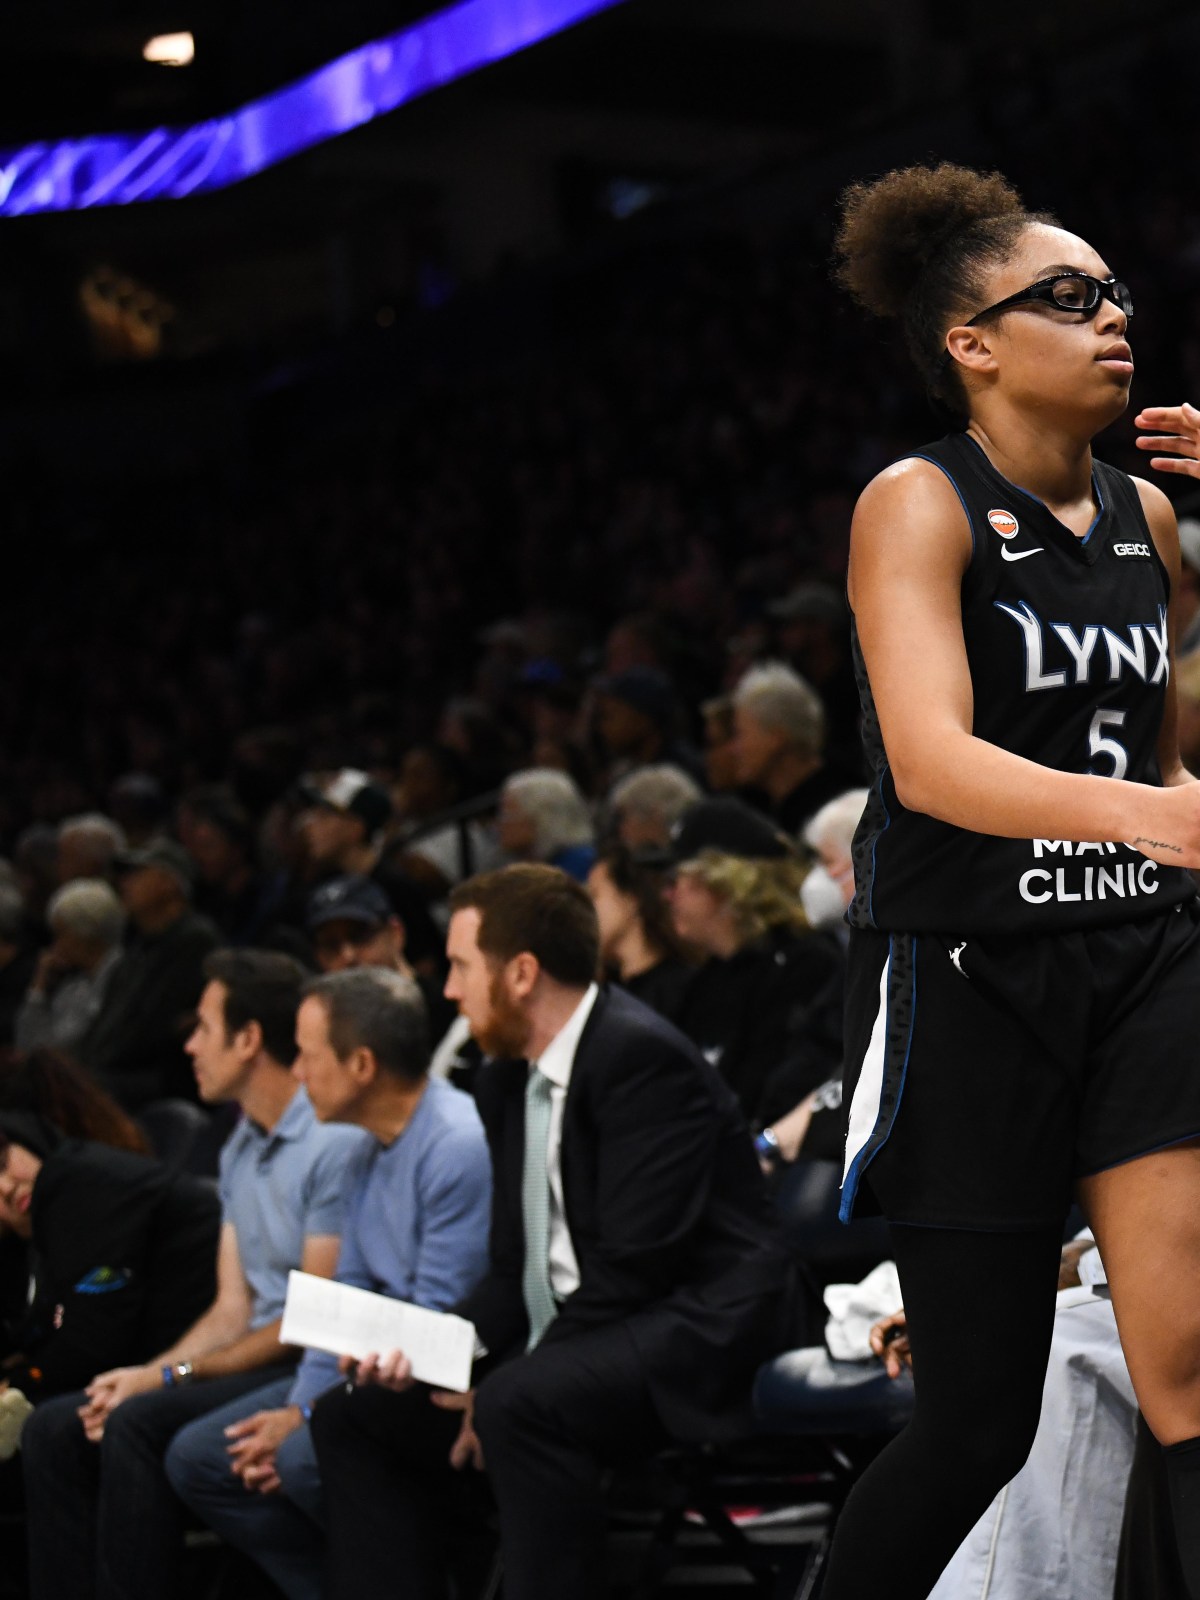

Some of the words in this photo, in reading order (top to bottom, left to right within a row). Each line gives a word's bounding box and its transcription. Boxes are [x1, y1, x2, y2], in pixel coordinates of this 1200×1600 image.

[993, 600, 1170, 693] LYNX
[1087, 706, 1128, 780] 5
[1018, 859, 1160, 904] CLINIC
